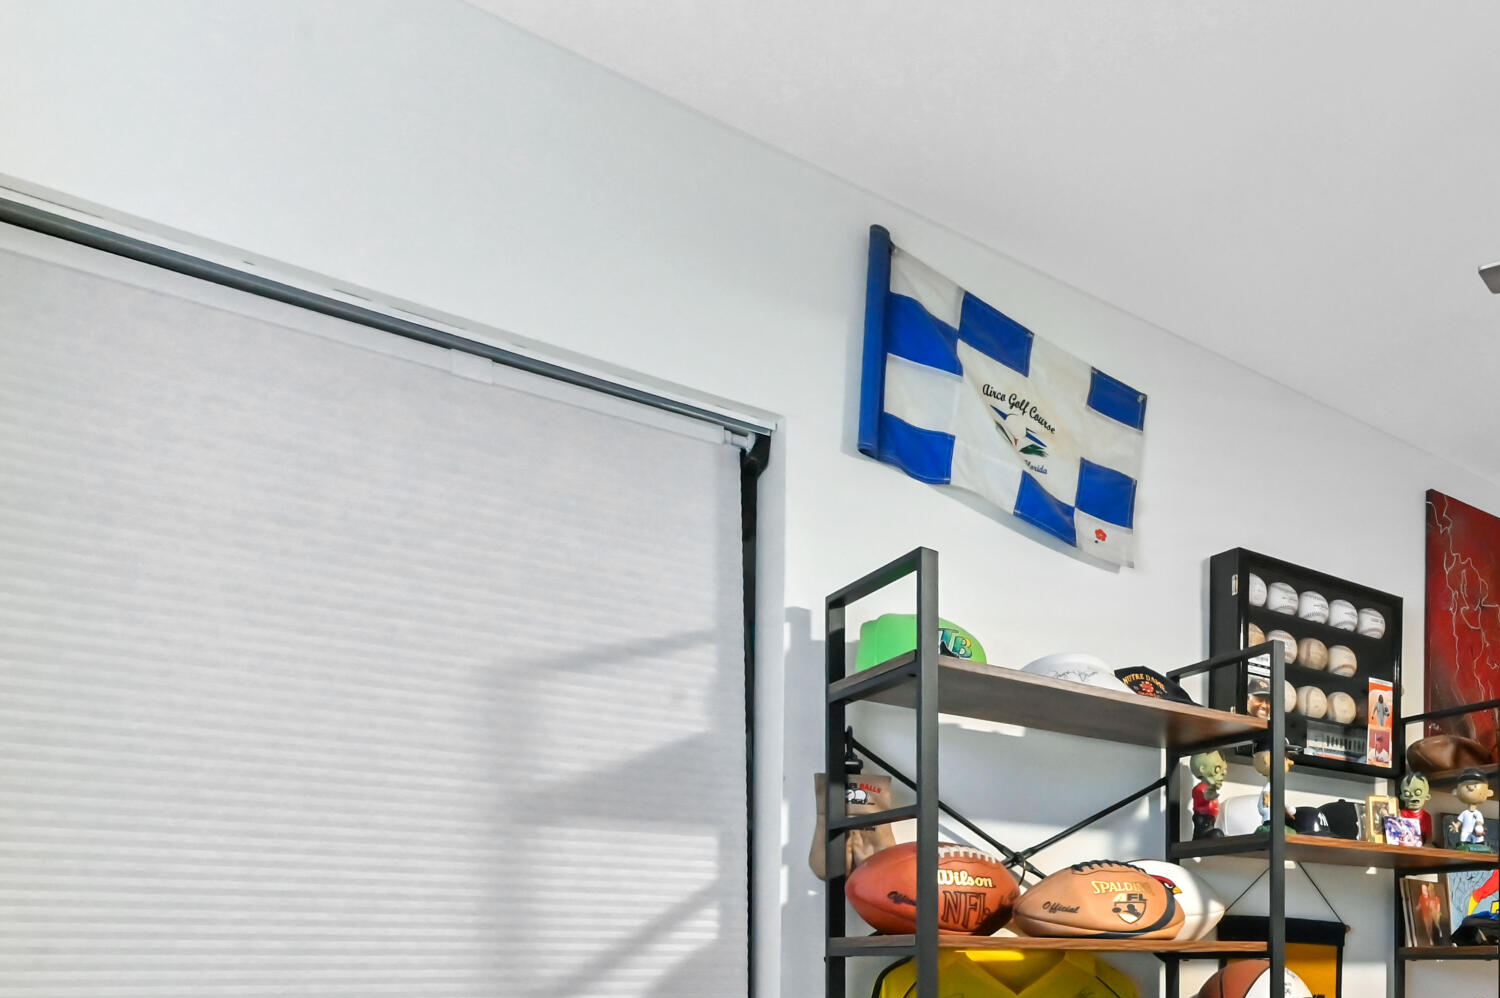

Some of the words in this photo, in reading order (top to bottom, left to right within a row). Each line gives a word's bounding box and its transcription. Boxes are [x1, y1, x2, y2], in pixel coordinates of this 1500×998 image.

[983, 384, 1006, 402] Airco
[1008, 393, 1030, 415] Golf
[1029, 406, 1056, 434] Course
[1122, 673, 1144, 684] NOTRE
[938, 869, 993, 888] Wilson
[1113, 893, 1148, 902] AFL
[941, 890, 986, 929] NFL
[1042, 900, 1080, 914] Official
